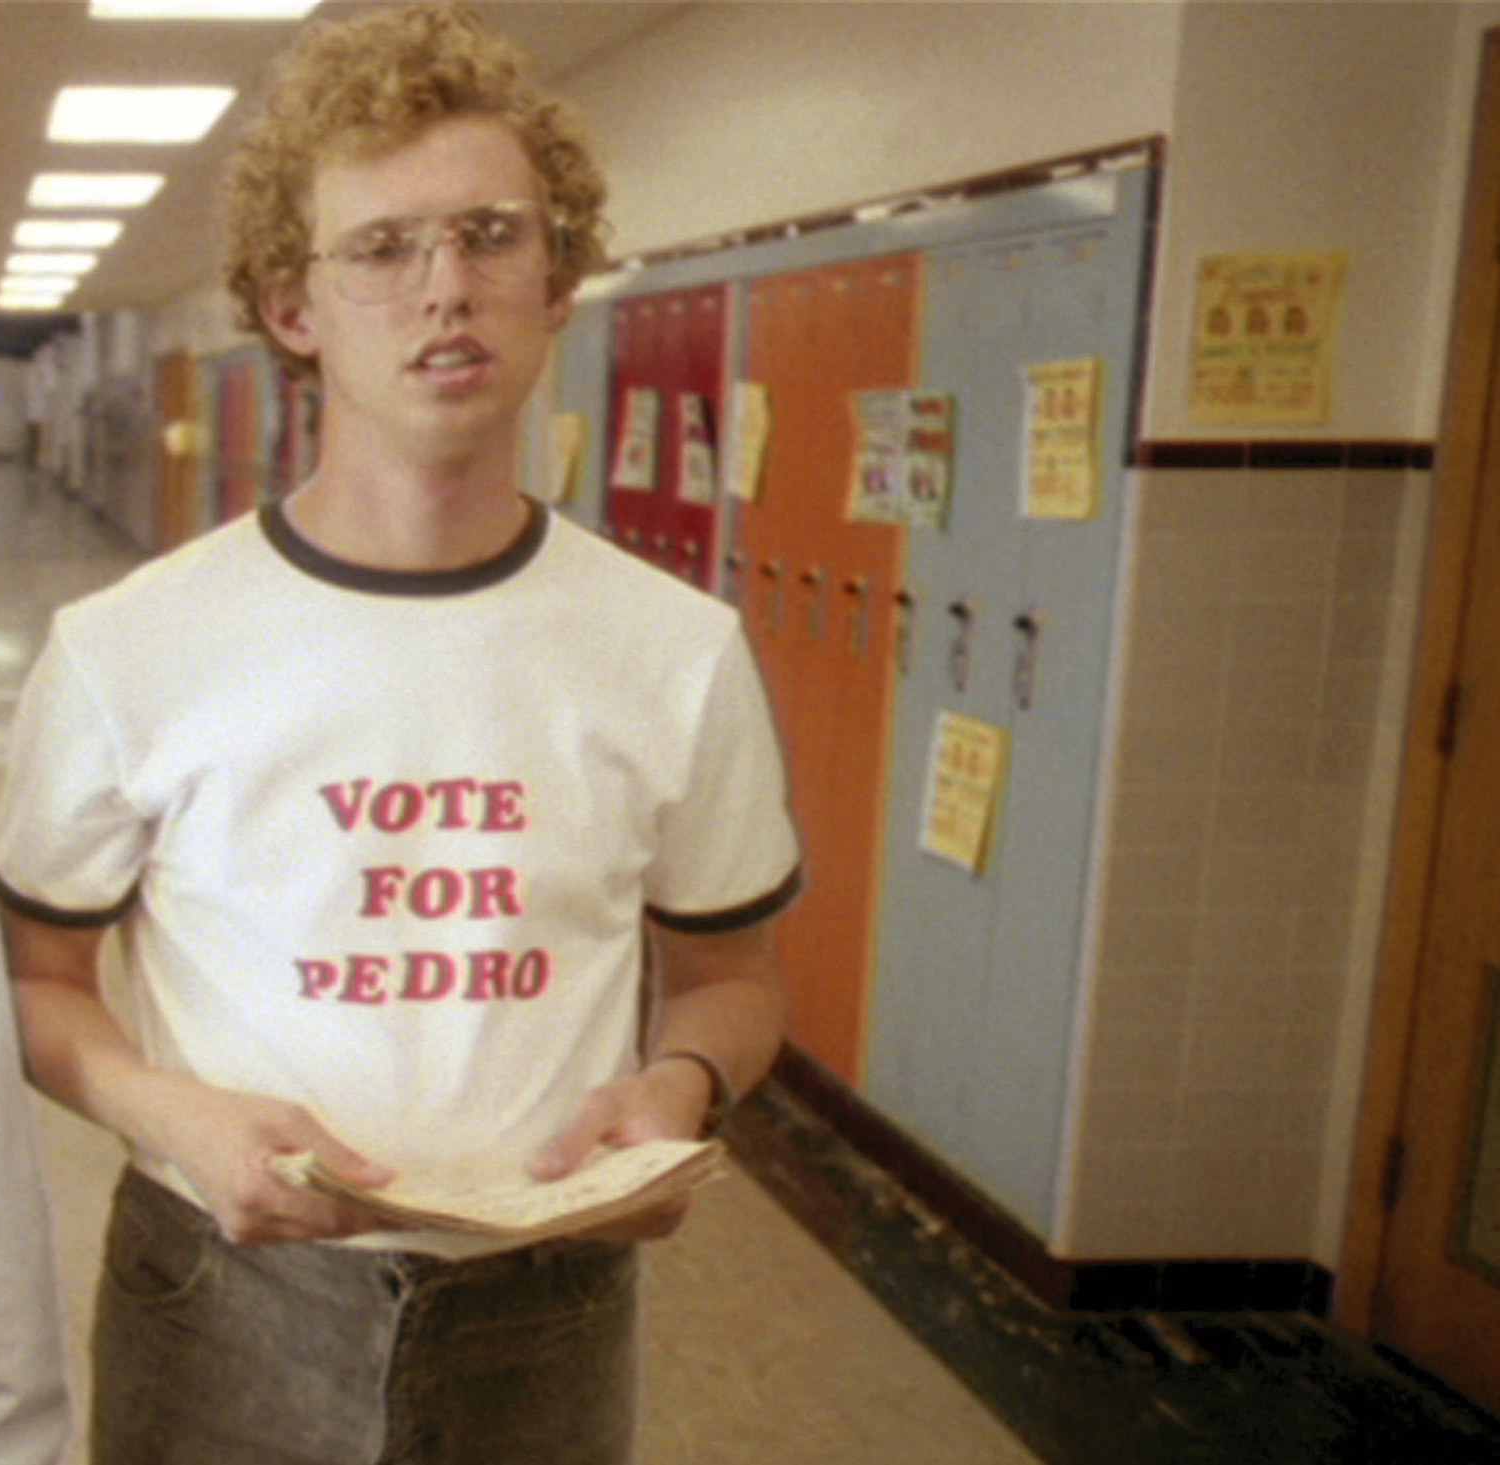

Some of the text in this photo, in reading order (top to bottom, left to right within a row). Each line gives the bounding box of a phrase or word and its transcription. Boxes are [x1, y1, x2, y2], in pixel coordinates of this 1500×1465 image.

[318, 778, 526, 833] VOTE
[359, 865, 523, 919] FOR
[294, 947, 550, 1005] PEDRO
